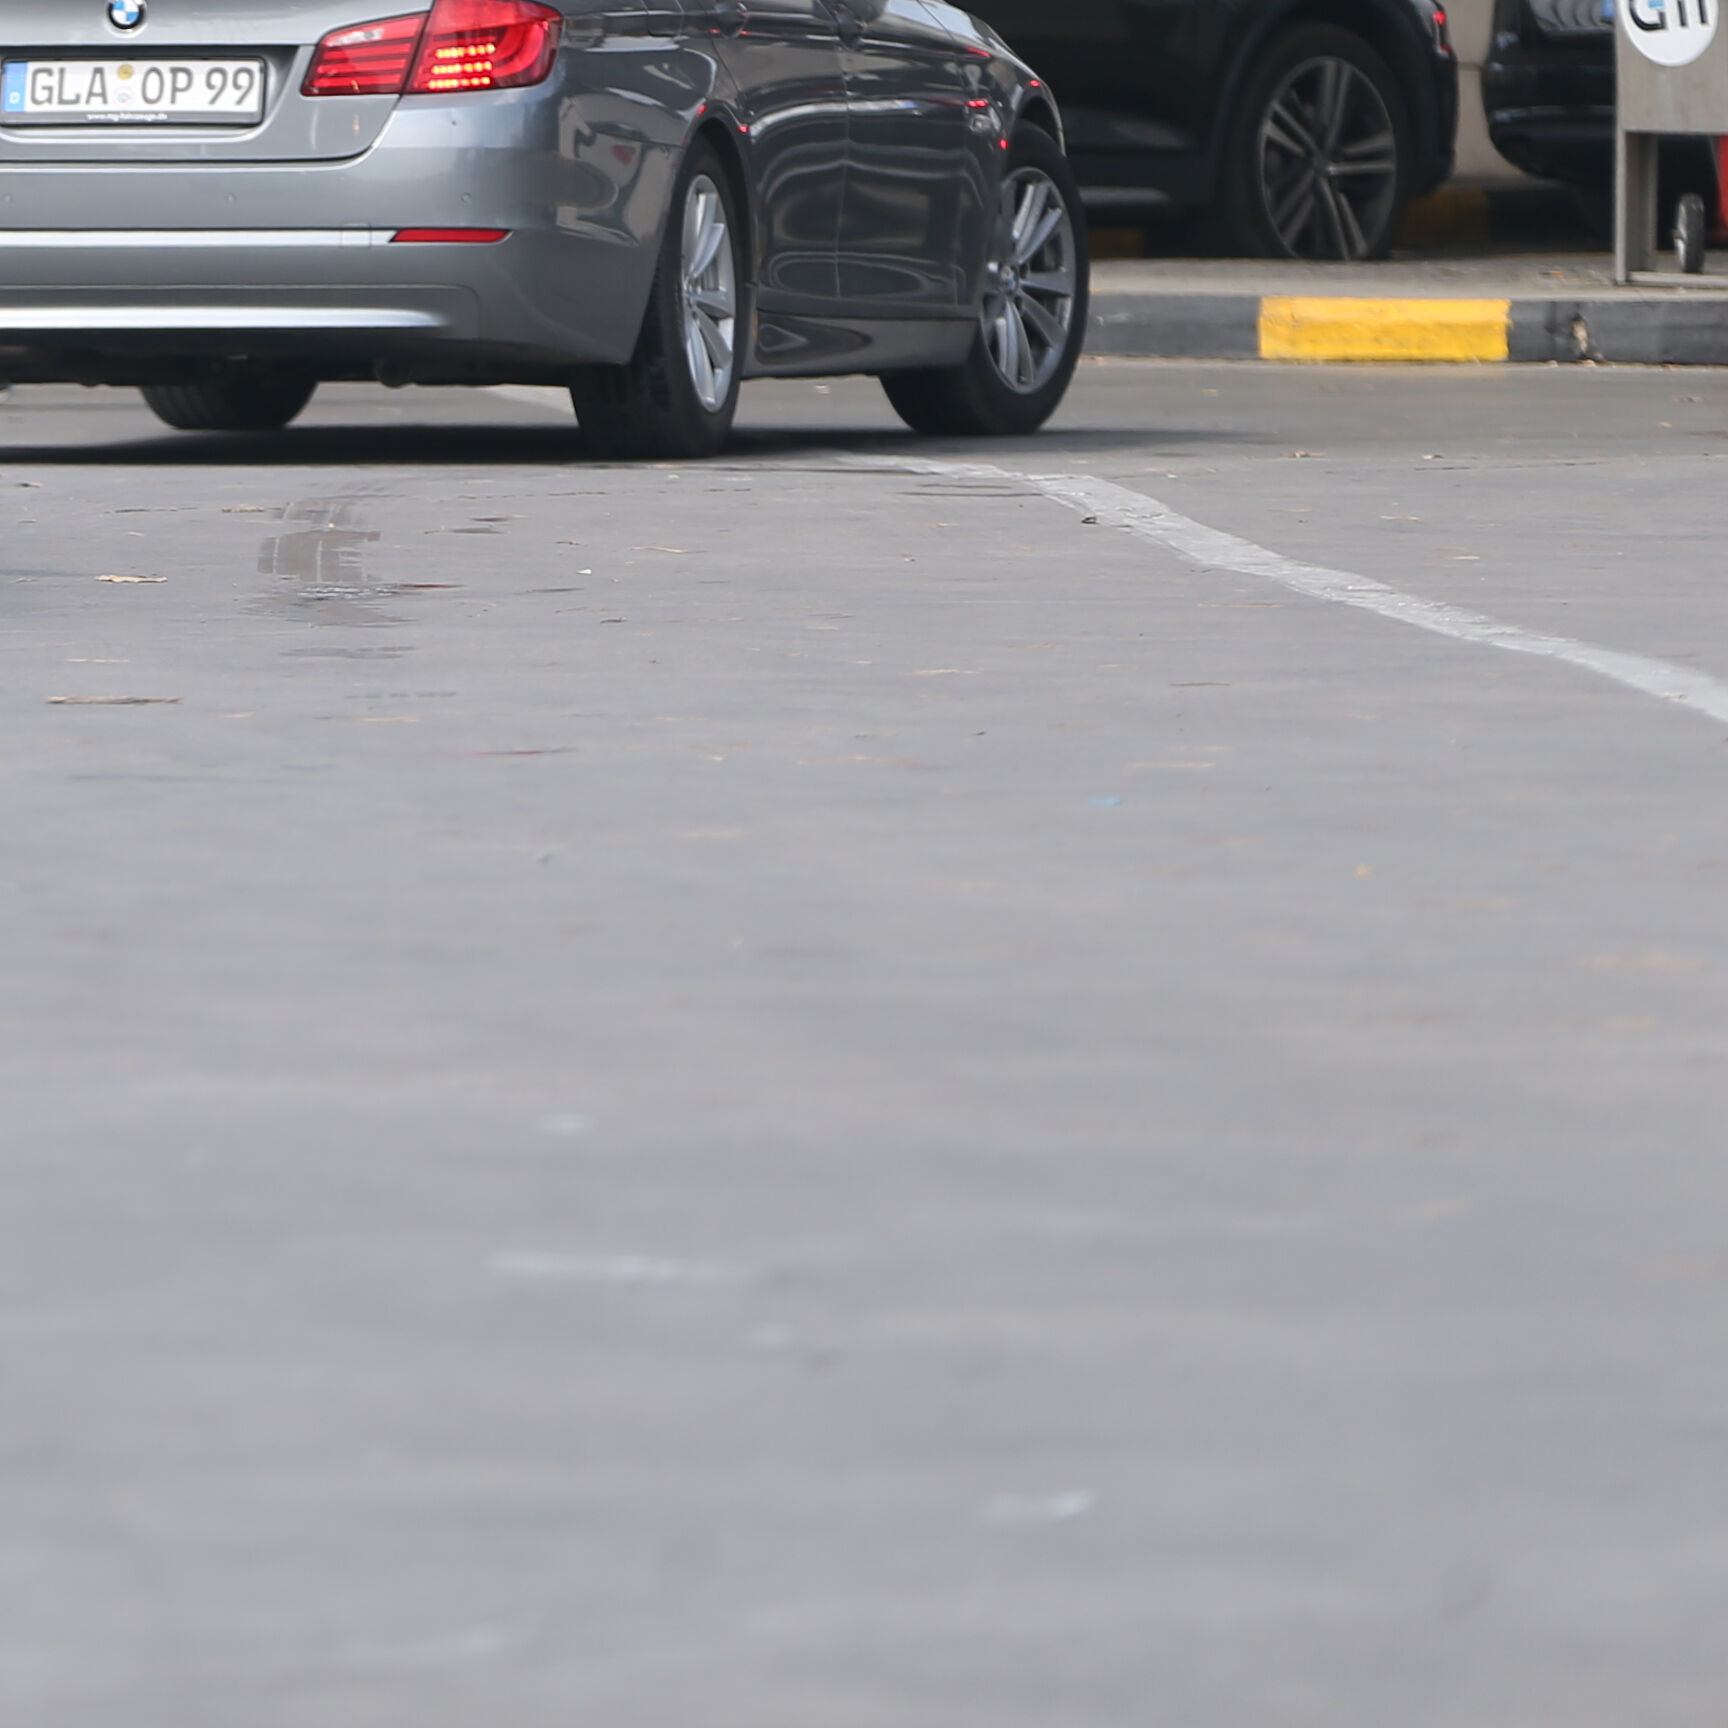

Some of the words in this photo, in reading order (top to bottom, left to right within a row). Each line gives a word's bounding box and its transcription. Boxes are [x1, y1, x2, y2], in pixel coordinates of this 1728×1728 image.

[9, 92, 20, 104] D
[30, 67, 108, 105] GLA
[141, 67, 193, 104] OP
[205, 67, 255, 105] 99
